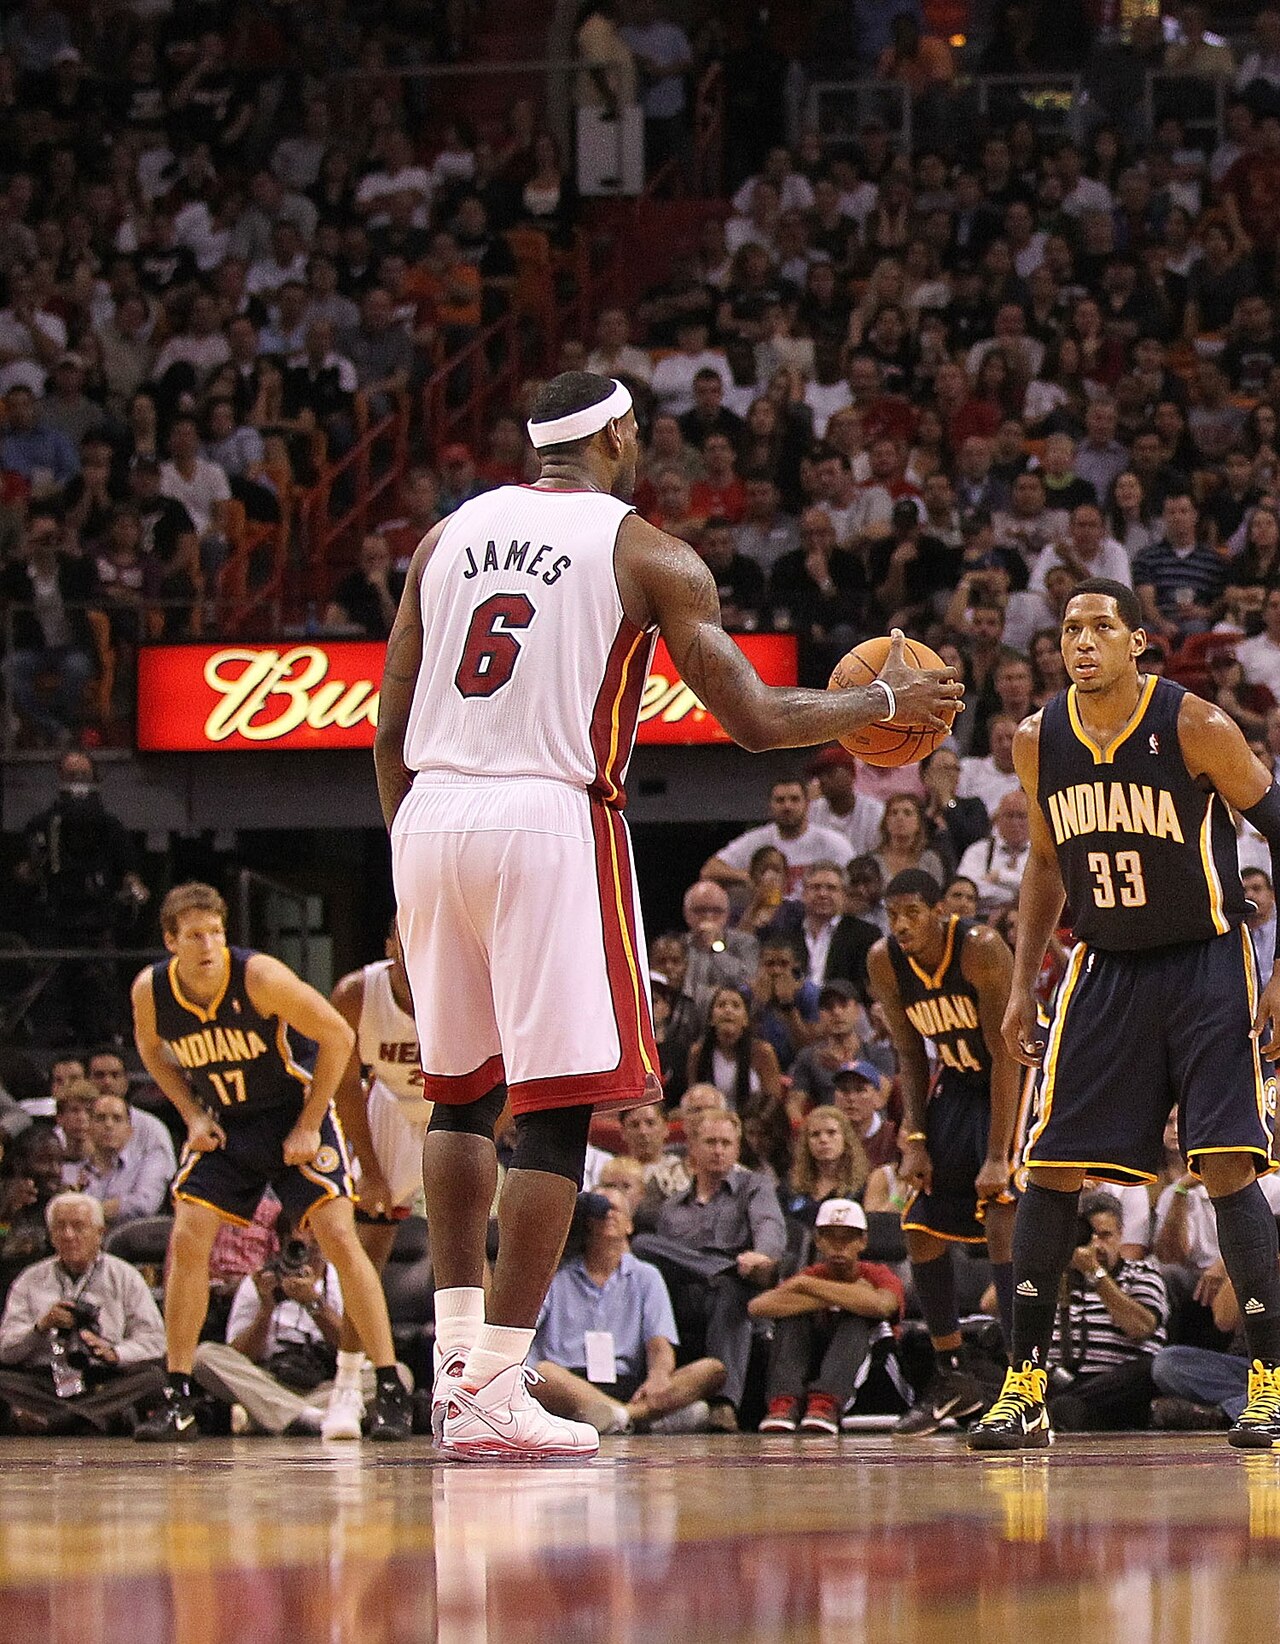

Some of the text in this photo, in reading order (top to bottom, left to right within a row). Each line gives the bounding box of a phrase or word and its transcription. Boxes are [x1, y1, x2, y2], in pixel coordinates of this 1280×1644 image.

[463, 539, 572, 586] JAMES
[454, 592, 537, 700] 6
[1047, 781, 1185, 846] INDIANA
[1087, 850, 1147, 909] 33
[905, 994, 979, 1036] NDIAN
[171, 1027, 268, 1068] NDIANA
[379, 1042, 420, 1064] HE
[939, 1038, 982, 1073] 44
[208, 1069, 247, 1106] 17
